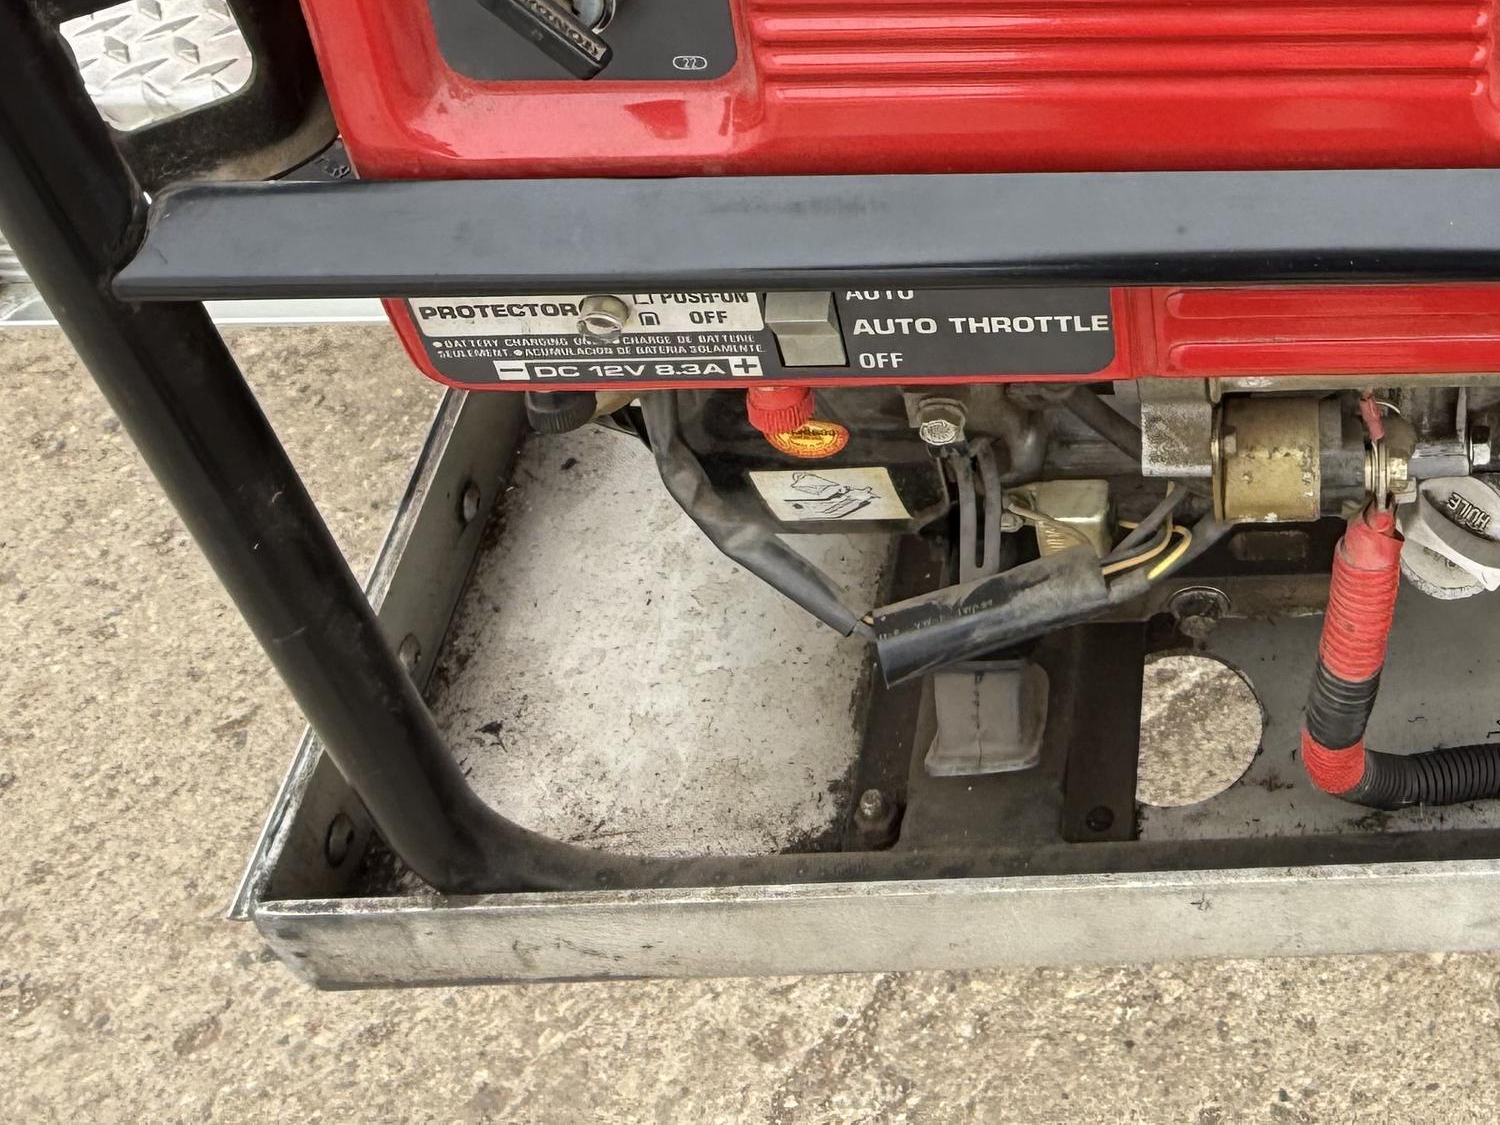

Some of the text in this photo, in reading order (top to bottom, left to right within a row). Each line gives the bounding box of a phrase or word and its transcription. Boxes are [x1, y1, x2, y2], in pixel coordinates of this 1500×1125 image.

[660, 292, 750, 304] PUSH-ON
[418, 303, 579, 320] PROTECTOR
[689, 311, 728, 324] OFF
[853, 315, 1110, 335] AUTO THROTTLE
[444, 338, 499, 348] BATTERY
[504, 337, 569, 347] CHARGING
[622, 335, 672, 345] CHARGE
[859, 353, 903, 368] OFF
[535, 364, 726, 378] DC 12V 8.3A
